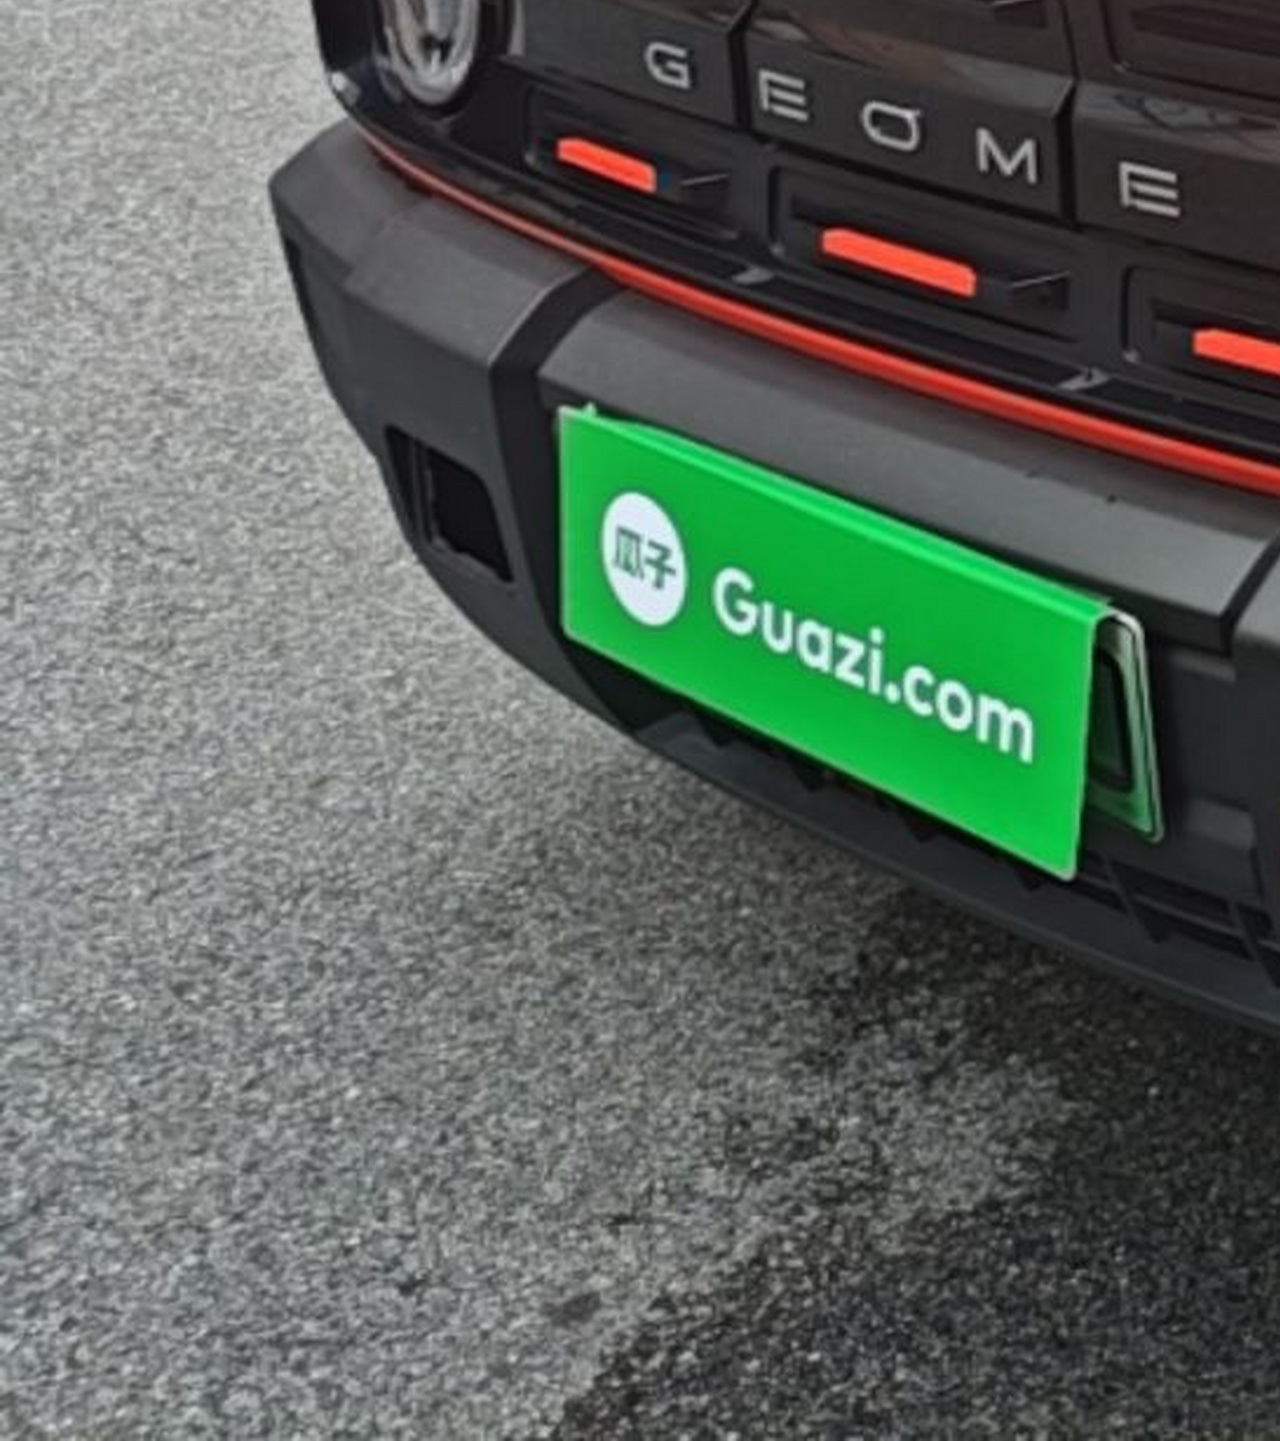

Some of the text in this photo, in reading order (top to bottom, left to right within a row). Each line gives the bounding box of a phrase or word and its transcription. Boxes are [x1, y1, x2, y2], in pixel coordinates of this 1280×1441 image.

[644, 41, 1180, 218] GEOME
[613, 525, 677, 590] 瓜子
[711, 566, 1034, 764] Guazi.com
